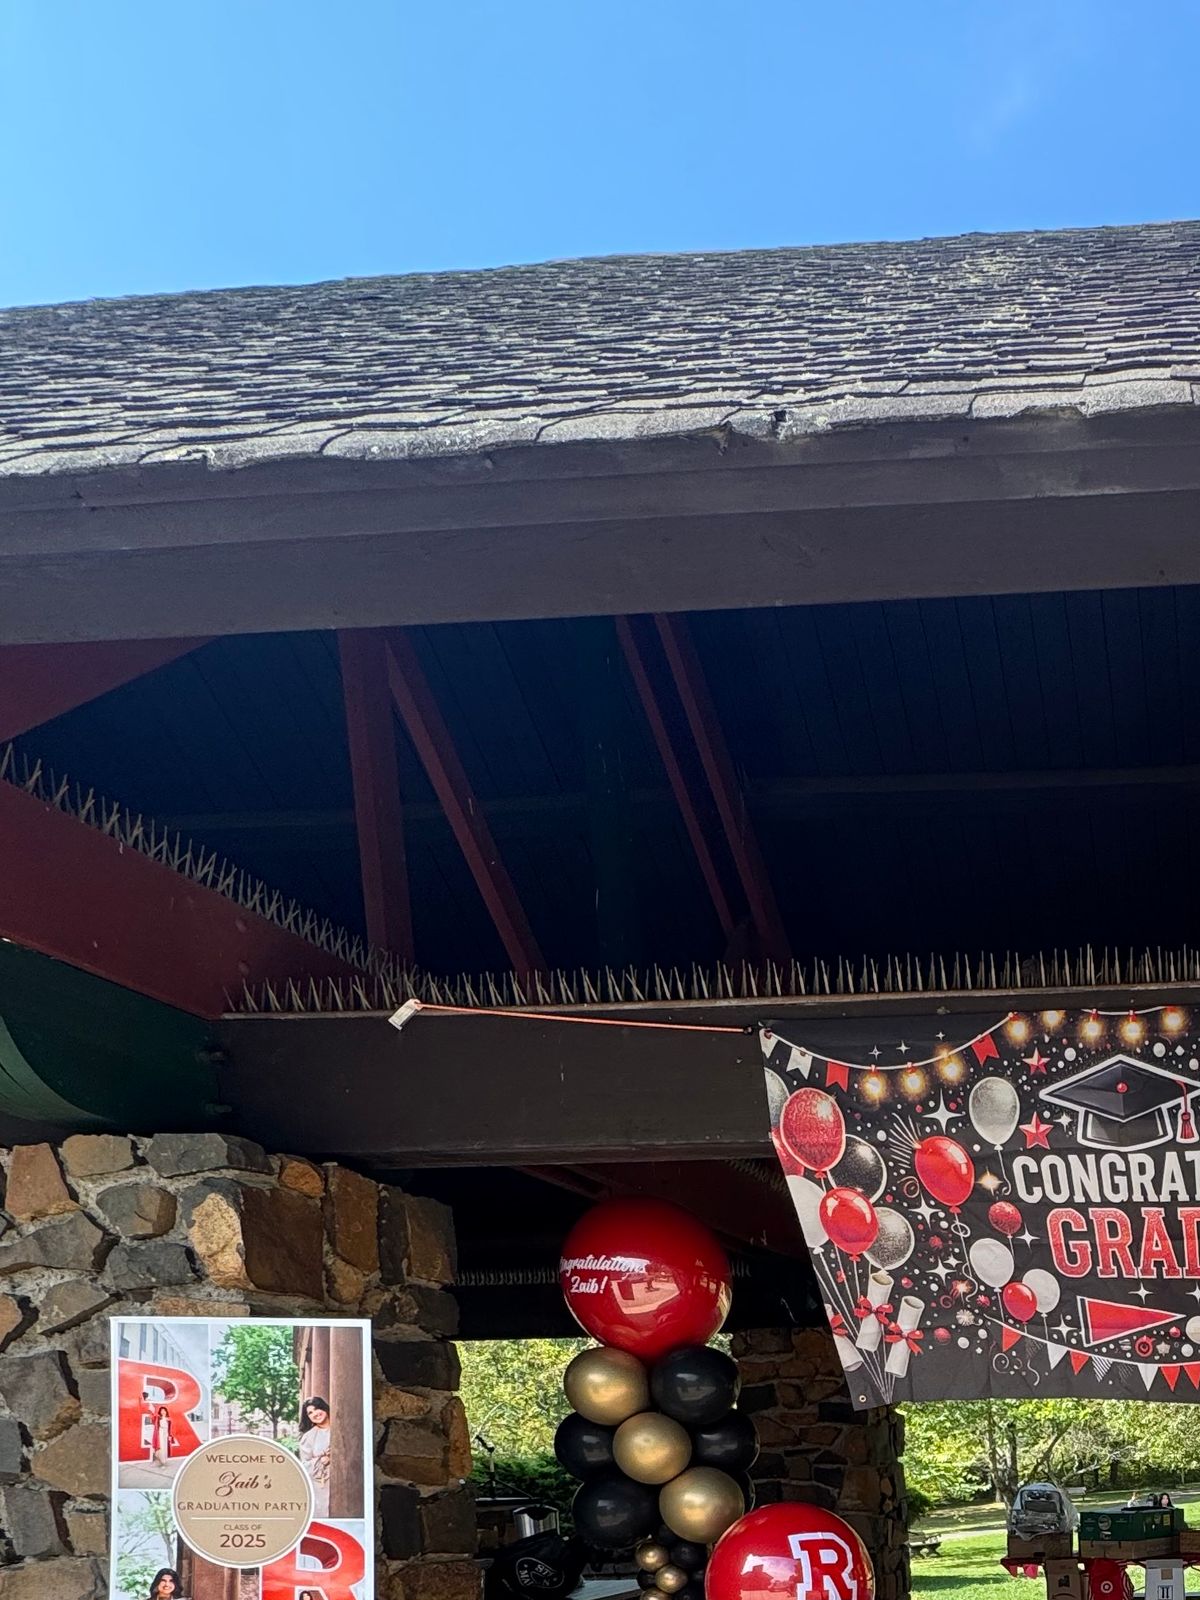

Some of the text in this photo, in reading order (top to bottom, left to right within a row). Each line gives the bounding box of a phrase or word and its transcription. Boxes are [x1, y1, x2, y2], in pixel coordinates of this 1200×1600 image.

[205, 1454, 286, 1464] WELCOME TO
[215, 1470, 273, 1498] Zaib's
[177, 1501, 308, 1512] GRADUATION PARTY!
[223, 1523, 263, 1531] CLASS OF
[220, 1533, 266, 1548] 2025
